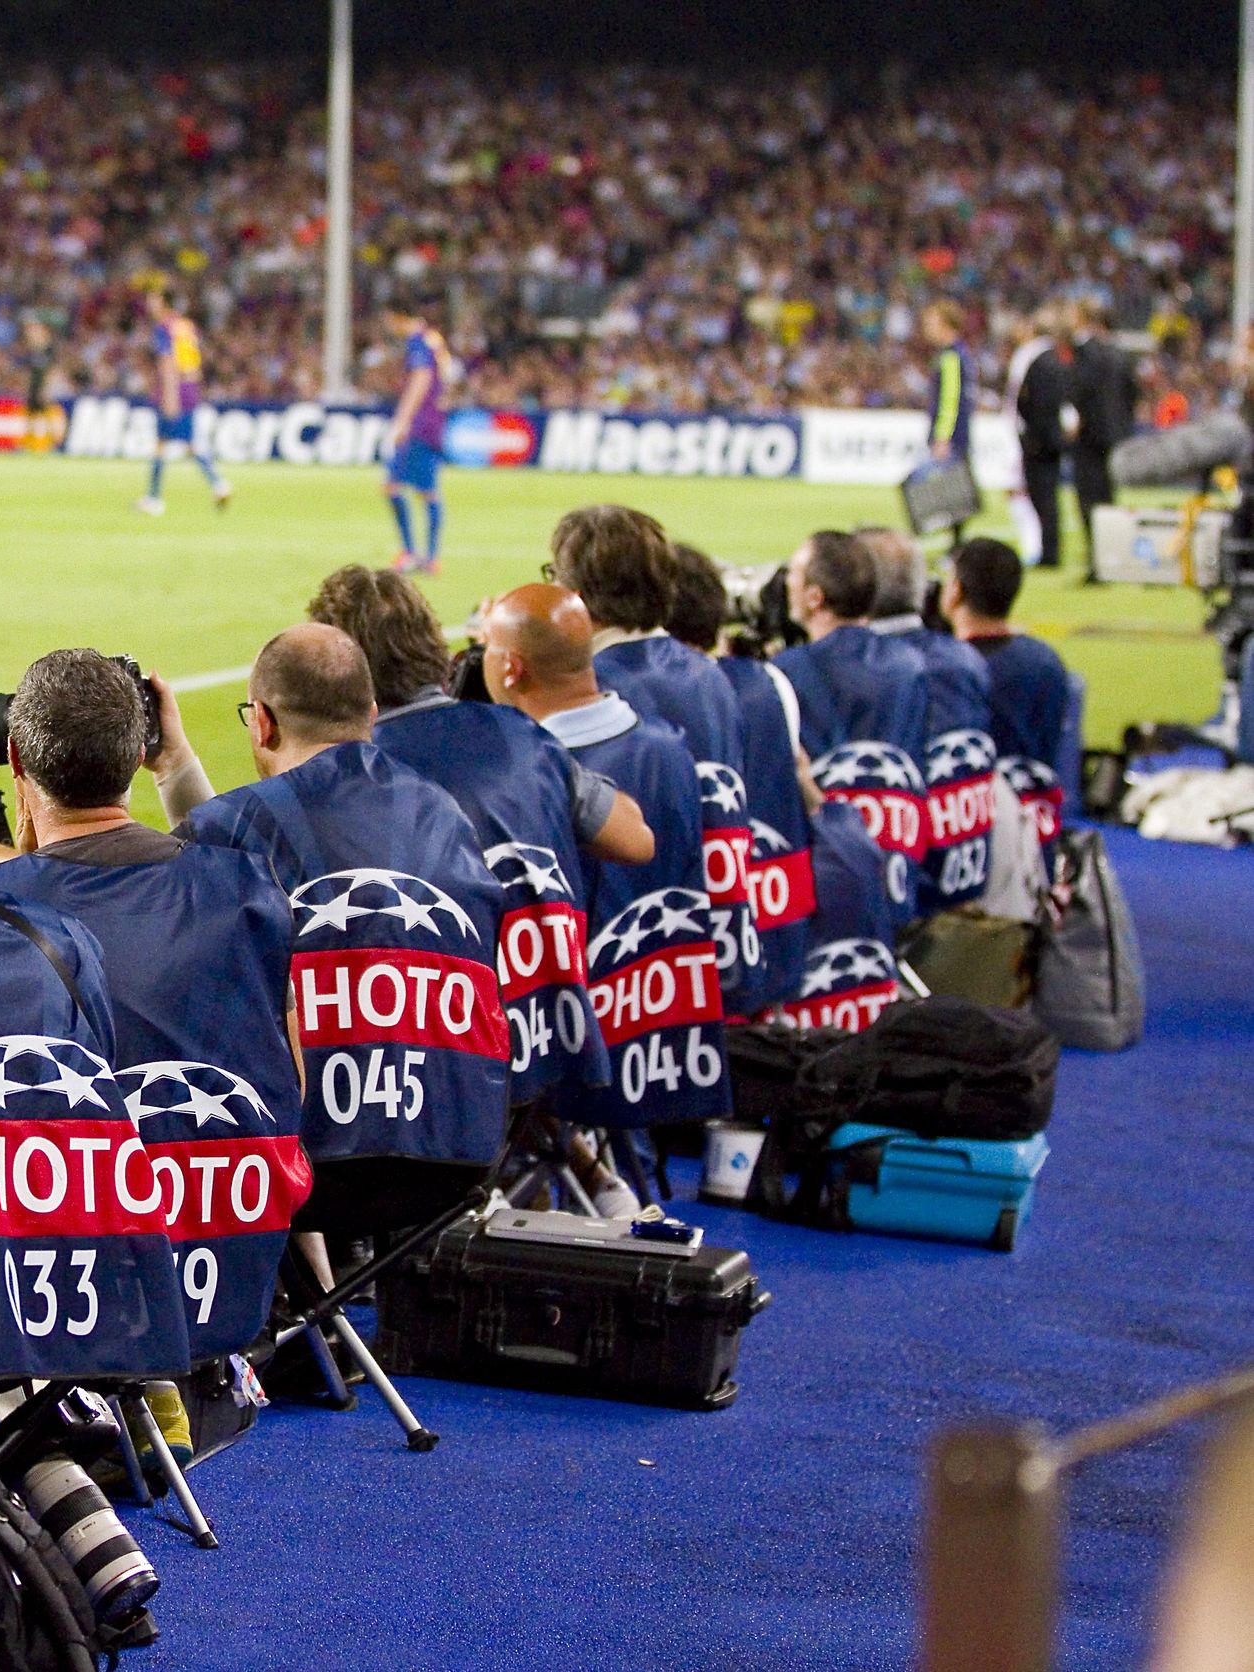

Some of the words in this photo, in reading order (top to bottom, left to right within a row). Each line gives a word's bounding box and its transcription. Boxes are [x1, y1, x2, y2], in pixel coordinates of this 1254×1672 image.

[64, 395, 396, 465] MaterCar
[541, 411, 798, 477] Maestro
[293, 963, 475, 1035] HOTO
[588, 953, 716, 1029] PHOT
[322, 1048, 426, 1125] 045
[622, 1026, 722, 1104] 046
[172, 1247, 218, 1325] 9
